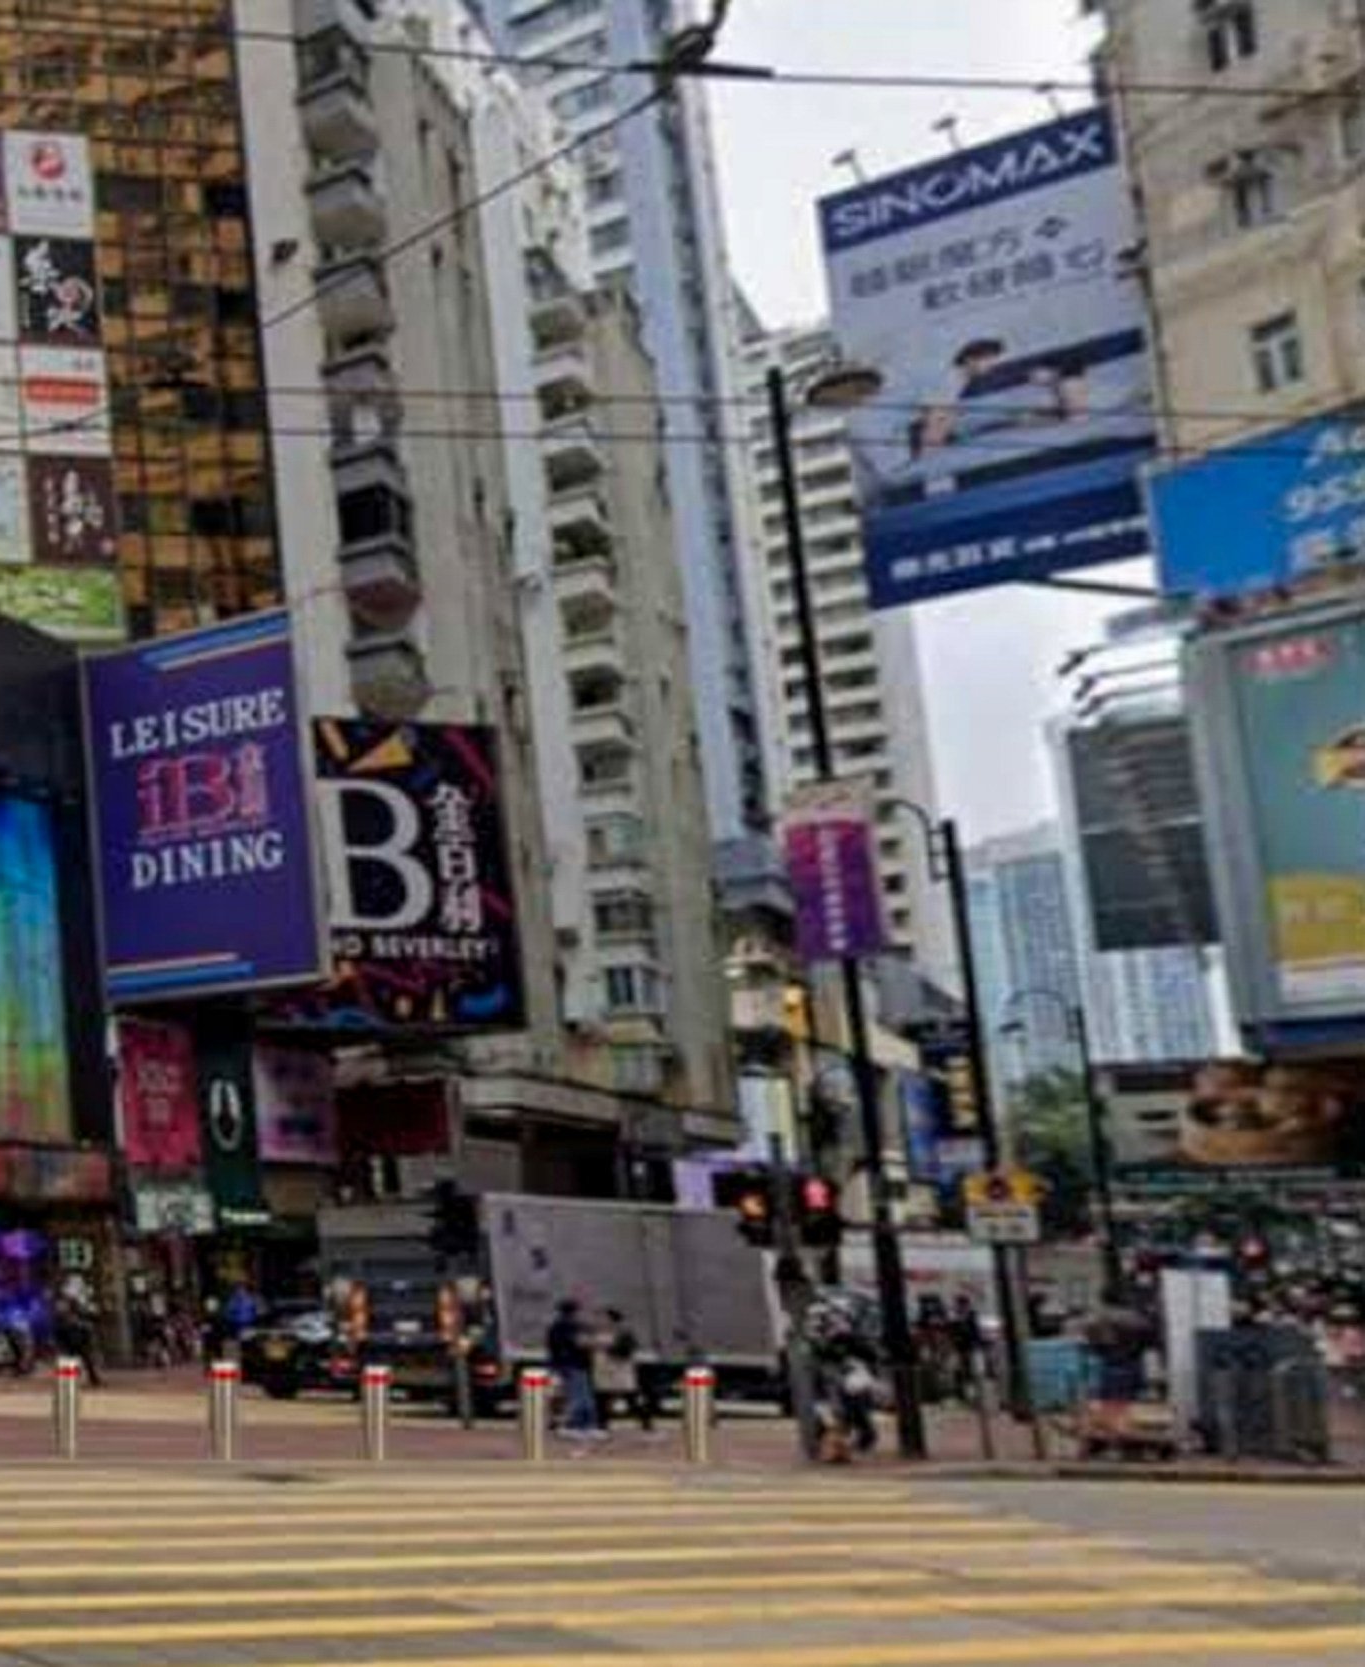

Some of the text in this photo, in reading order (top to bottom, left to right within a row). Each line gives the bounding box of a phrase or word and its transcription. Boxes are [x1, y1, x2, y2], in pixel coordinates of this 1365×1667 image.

[831, 122, 1103, 237] SINOMAX
[110, 688, 286, 759] LEISURE
[131, 831, 286, 891] DINING
